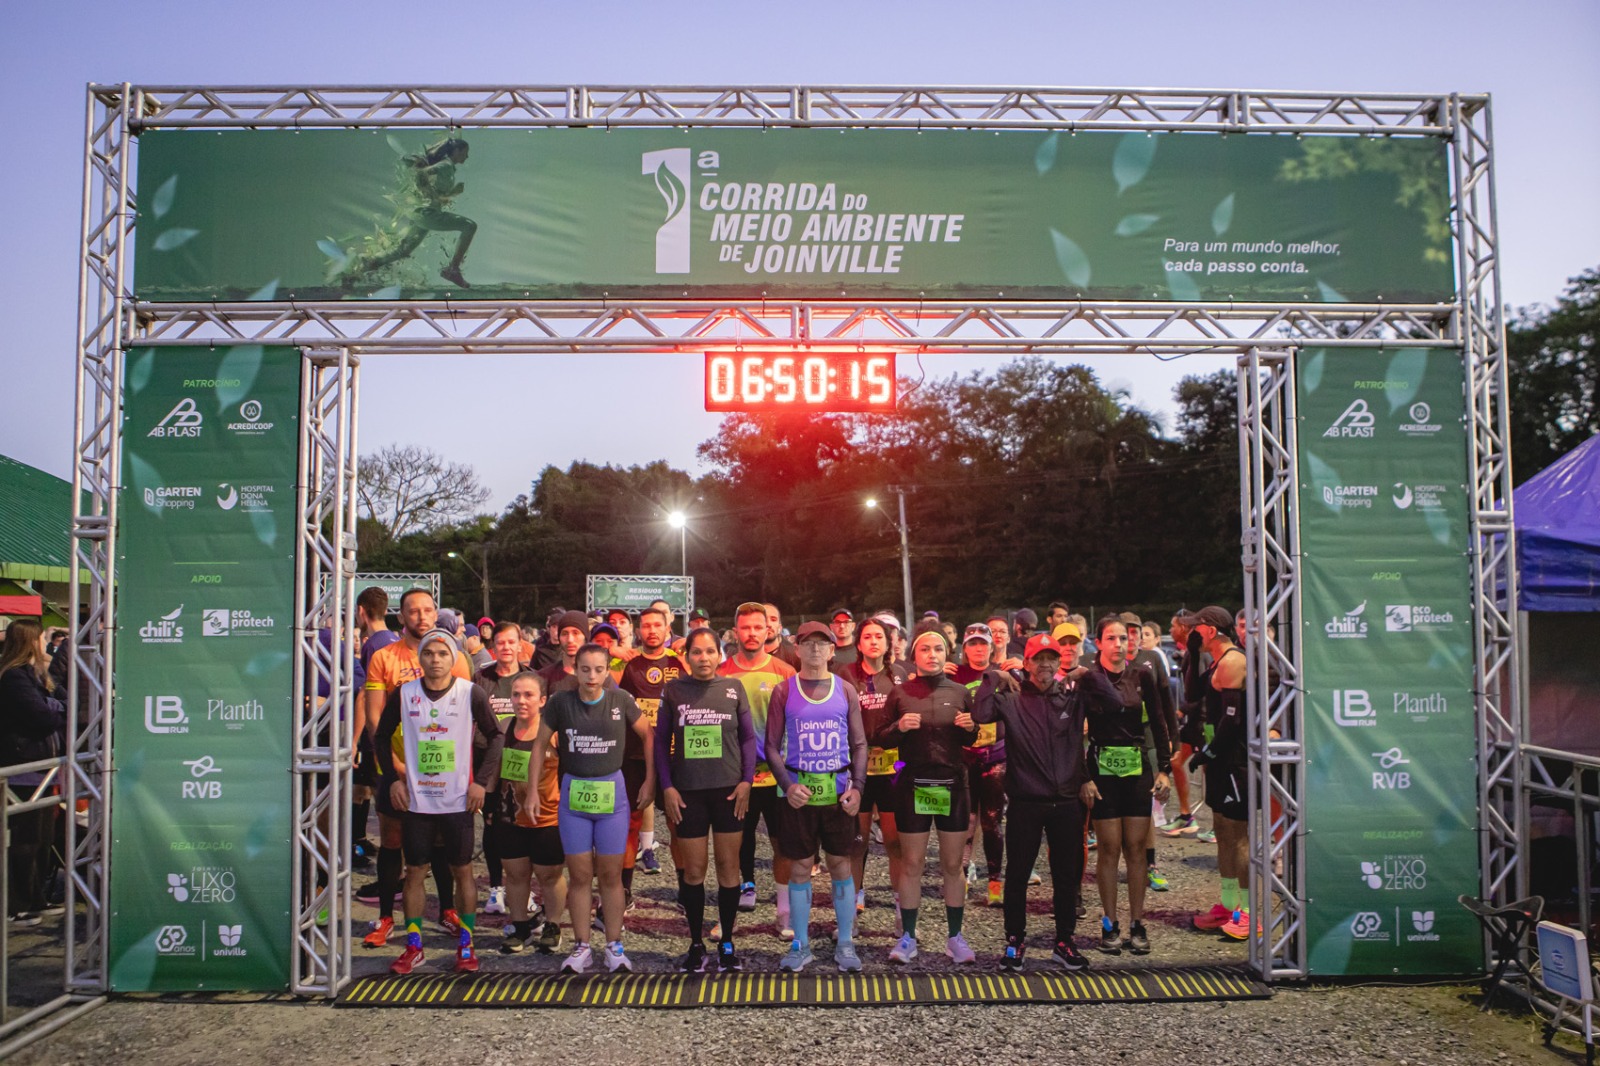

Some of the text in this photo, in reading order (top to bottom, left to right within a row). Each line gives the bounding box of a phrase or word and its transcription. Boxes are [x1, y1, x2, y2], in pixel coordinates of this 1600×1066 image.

[699, 183, 868, 211] CORRIDA DO
[709, 214, 964, 242] MEIO AMBIENTE
[1164, 238, 1341, 255] Para um mundo melhor,
[719, 245, 904, 273] DE JOINVILLE
[1165, 259, 1309, 275] cada passo conta.
[183, 378, 240, 388] PATROCÍNIO
[709, 356, 891, 404] 06:50:15
[147, 426, 203, 437] AB PLAST
[227, 423, 274, 431] ACREDICOOP
[1322, 426, 1376, 437] AB PLAST
[156, 486, 202, 497] GARTEN
[1334, 486, 1378, 496] GARTEN
[156, 498, 195, 509] Shopping
[1335, 497, 1372, 508] Shopping
[190, 575, 222, 583] APOIO
[1371, 572, 1402, 580] APOIO
[231, 610, 251, 618] eco
[1413, 605, 1431, 614] eco
[231, 616, 274, 629] protech
[1413, 611, 1453, 625] protech
[139, 621, 184, 637] chili's
[1325, 616, 1368, 633] chili's
[1393, 692, 1447, 713] Planth
[207, 699, 264, 720] Planth
[590, 740, 616, 748] AMBIENTE
[688, 737, 709, 748] 796
[798, 731, 840, 751] run
[420, 753, 442, 763] 870
[799, 756, 841, 771] brasil
[1106, 758, 1126, 768] 853
[507, 760, 523, 772] 777
[1372, 772, 1411, 789] RVB
[182, 781, 222, 798] RVB
[806, 785, 823, 795] 99
[577, 792, 598, 803] 703
[1363, 830, 1424, 840] REALIZAÇÃO
[170, 841, 233, 851] REALIZAÇÃO
[1384, 860, 1426, 877] LIXO
[191, 871, 235, 889] LIXO
[1384, 875, 1426, 890] ZERO
[191, 888, 235, 903] ZERO
[1368, 930, 1390, 938] anos
[1407, 933, 1440, 941] univille
[213, 947, 247, 956] univille
